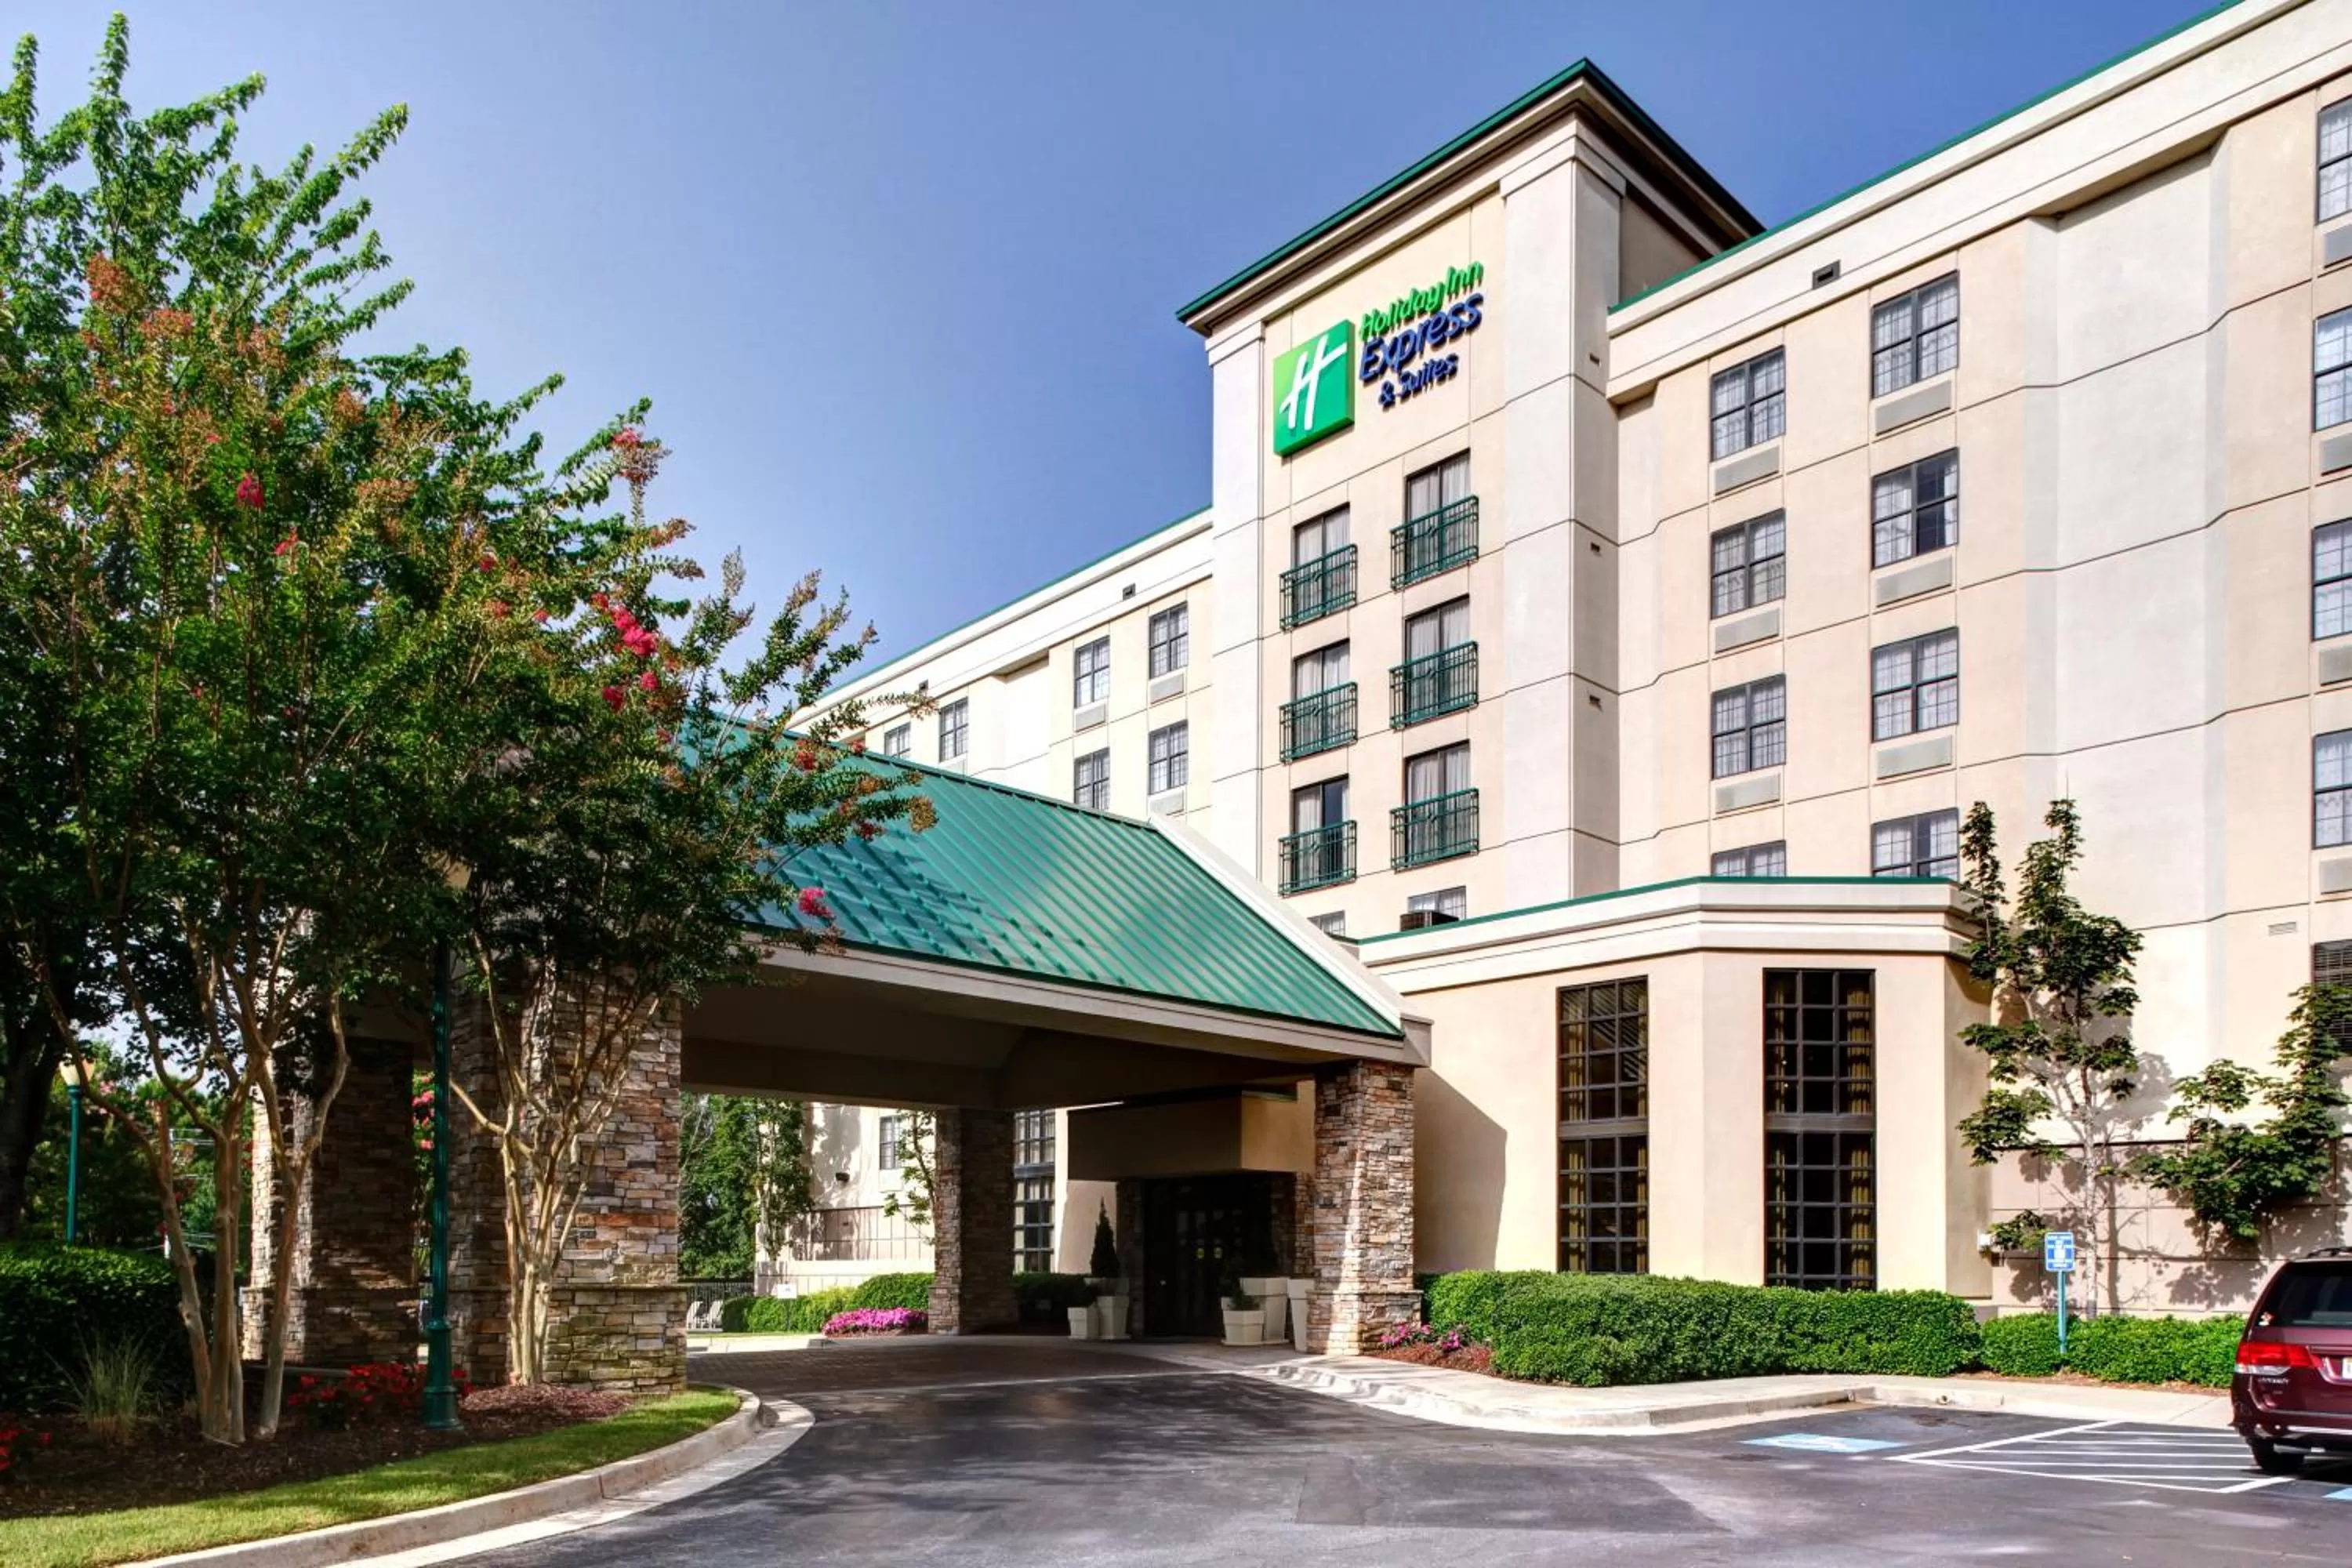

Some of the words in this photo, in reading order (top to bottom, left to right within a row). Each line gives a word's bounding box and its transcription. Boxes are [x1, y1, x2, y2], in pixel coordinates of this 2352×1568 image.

[1359, 282, 1446, 340] Holiday
[1446, 261, 1484, 298] Inn
[1359, 292, 1484, 383] Express
[1378, 381, 1396, 408] &
[1399, 354, 1458, 401] Suites
